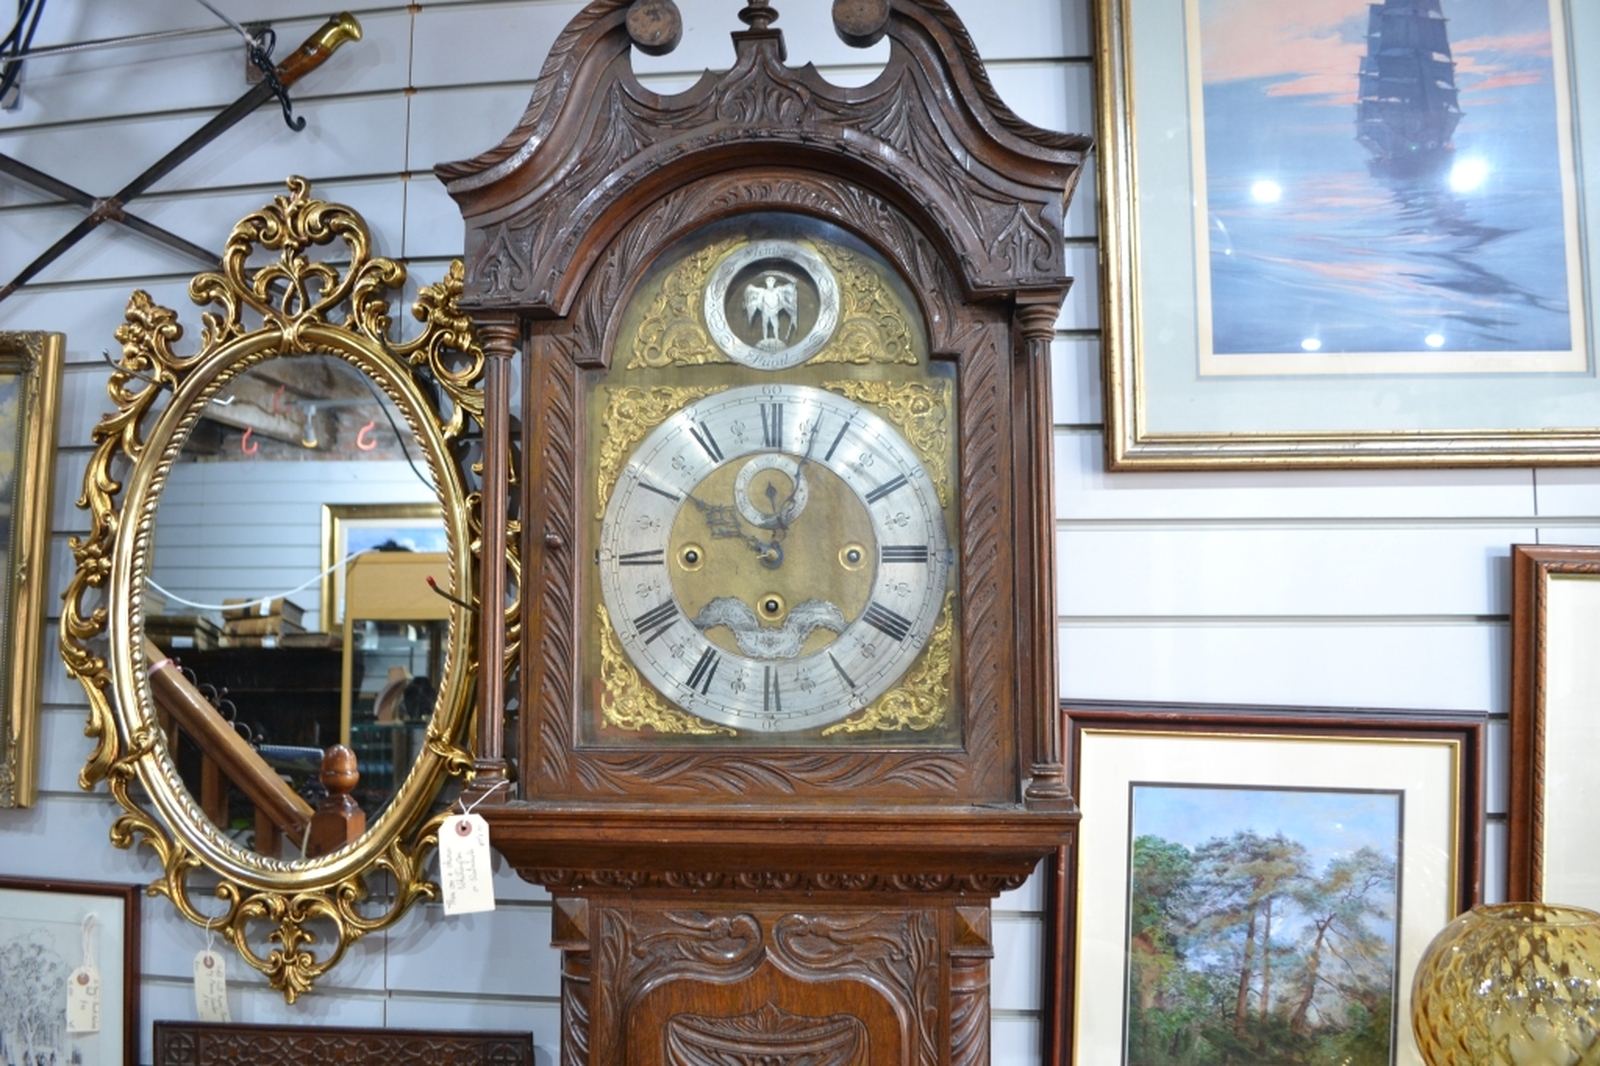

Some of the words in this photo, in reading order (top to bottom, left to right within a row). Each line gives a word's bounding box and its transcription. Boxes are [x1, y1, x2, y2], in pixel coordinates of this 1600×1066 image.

[762, 384, 783, 396] 60
[910, 463, 926, 479] 10
[864, 474, 909, 505] II
[880, 545, 929, 564] III
